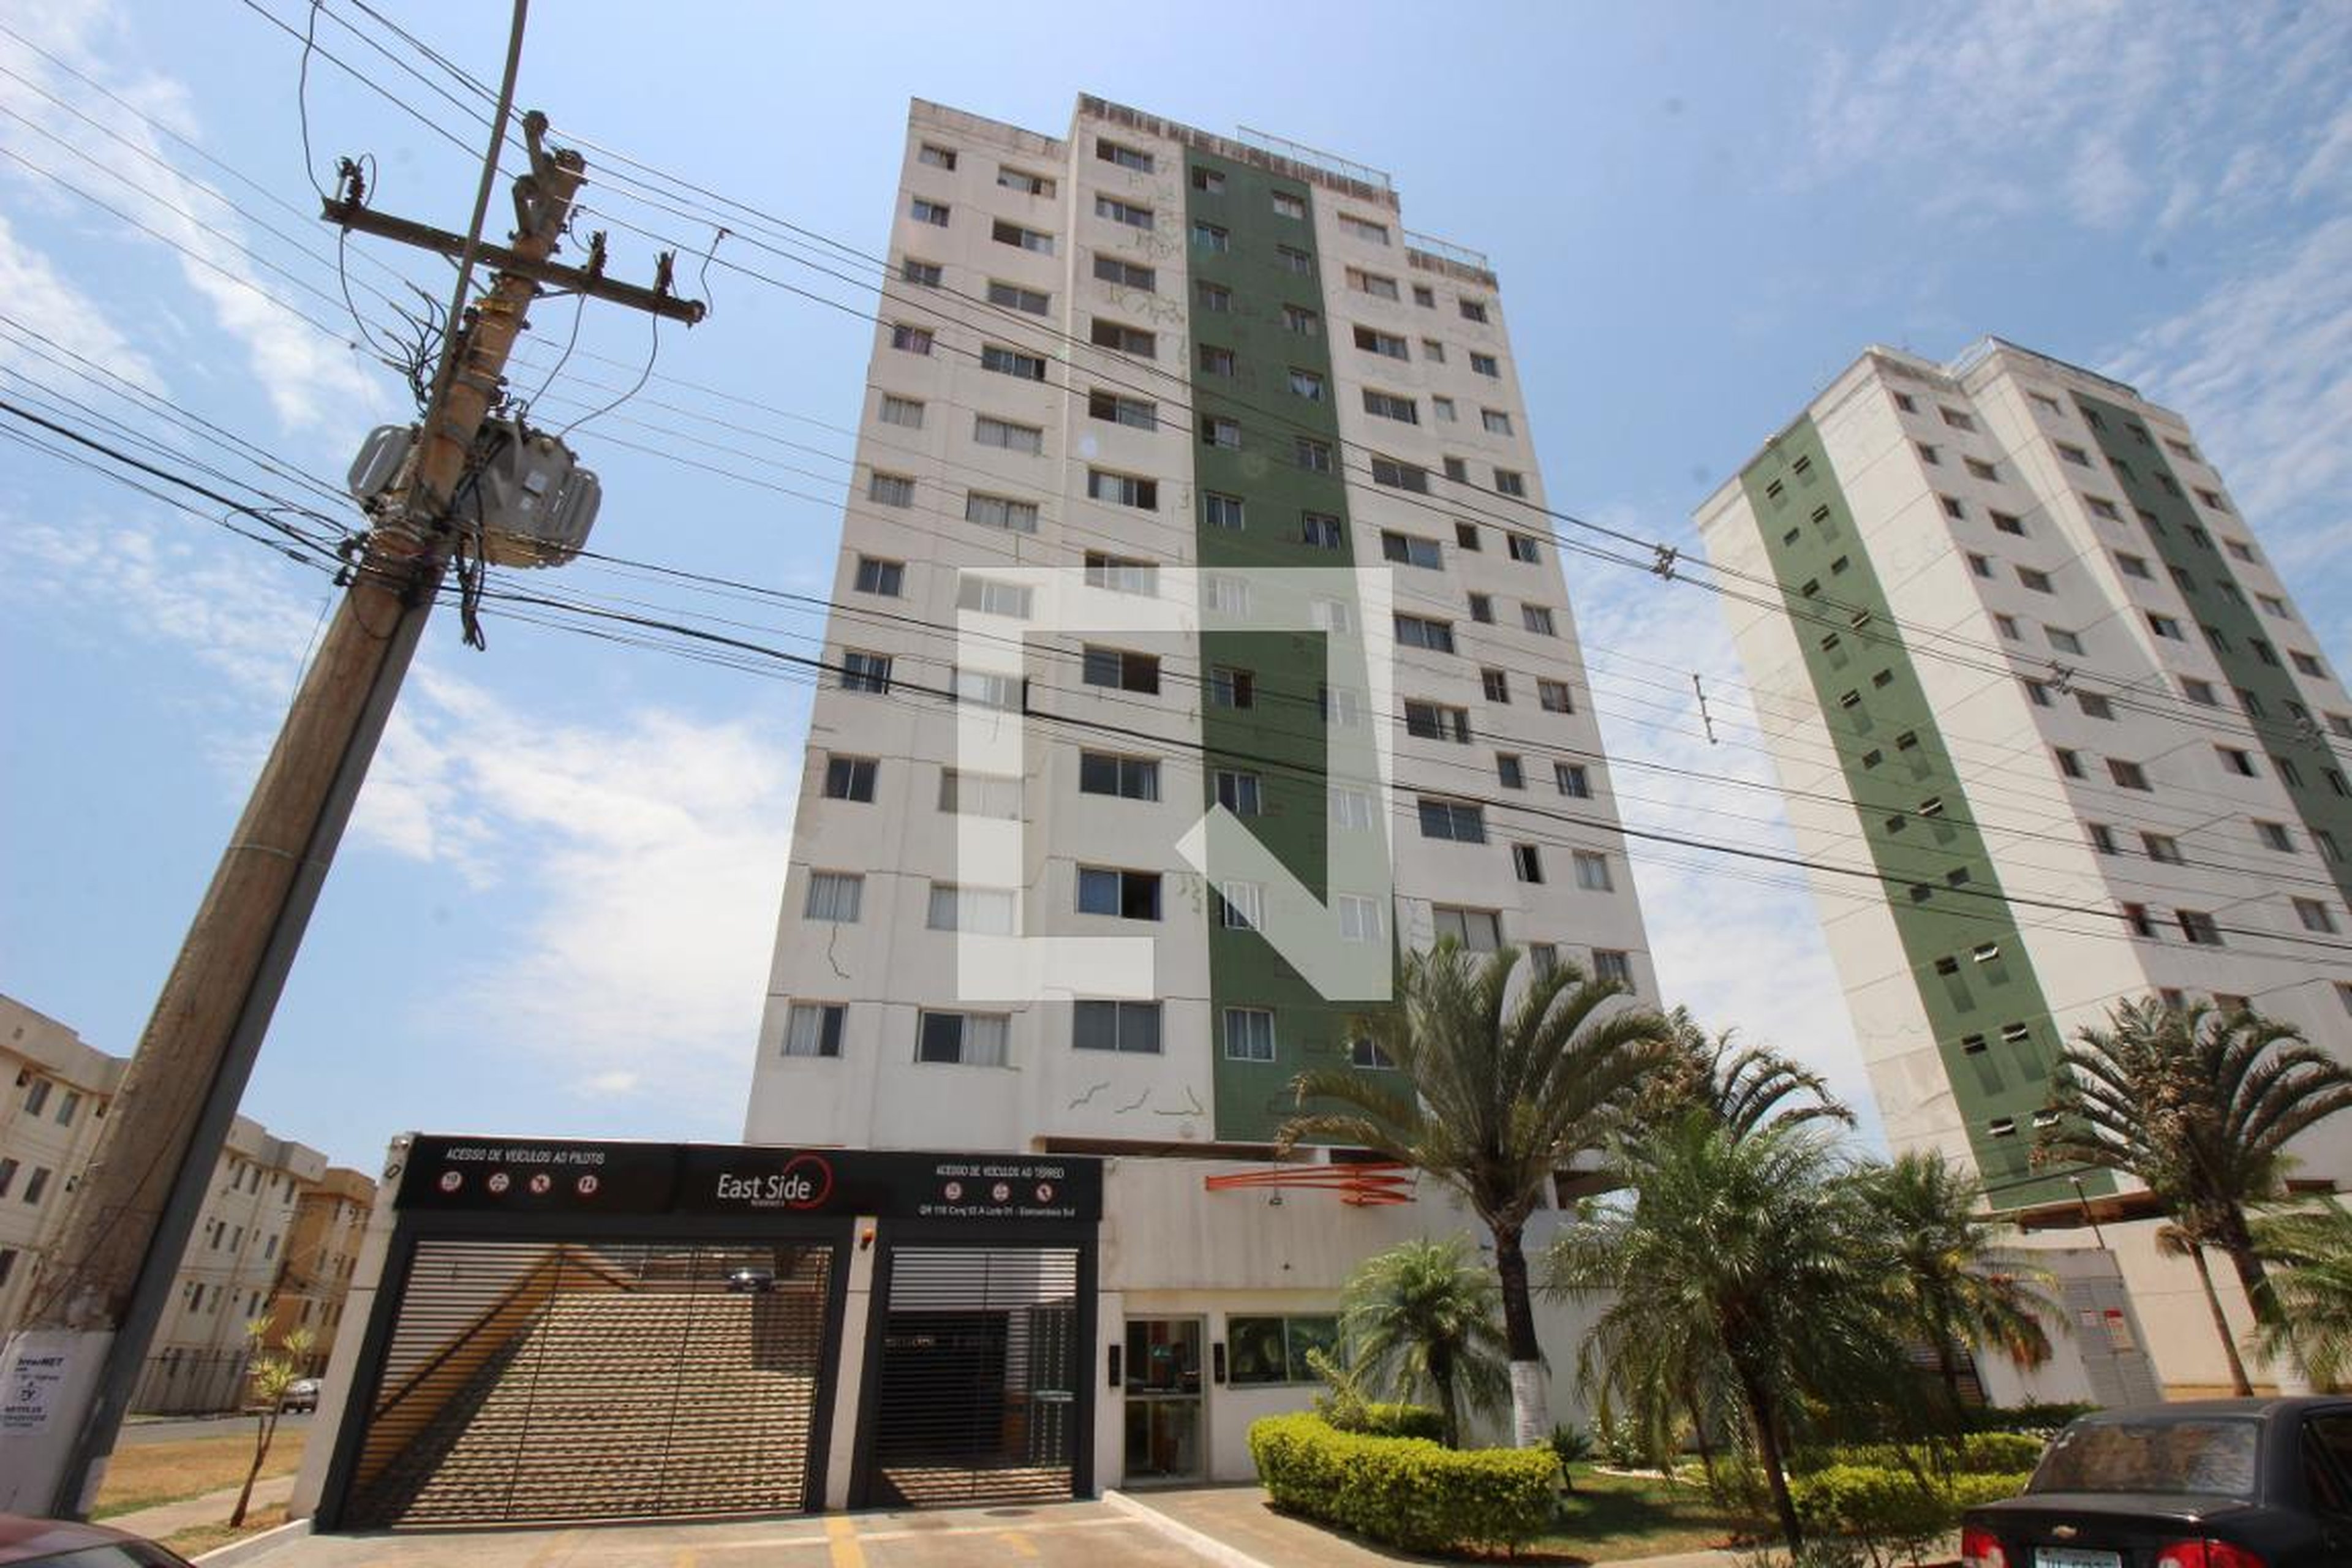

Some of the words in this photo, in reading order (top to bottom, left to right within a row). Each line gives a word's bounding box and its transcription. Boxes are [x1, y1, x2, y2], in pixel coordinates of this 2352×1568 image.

[447, 1148, 486, 1161] ACESSO
[488, 1149, 503, 1161] DE
[552, 1152, 568, 1164] AO
[717, 1173, 763, 1199] East
[766, 1173, 811, 1200] Side
